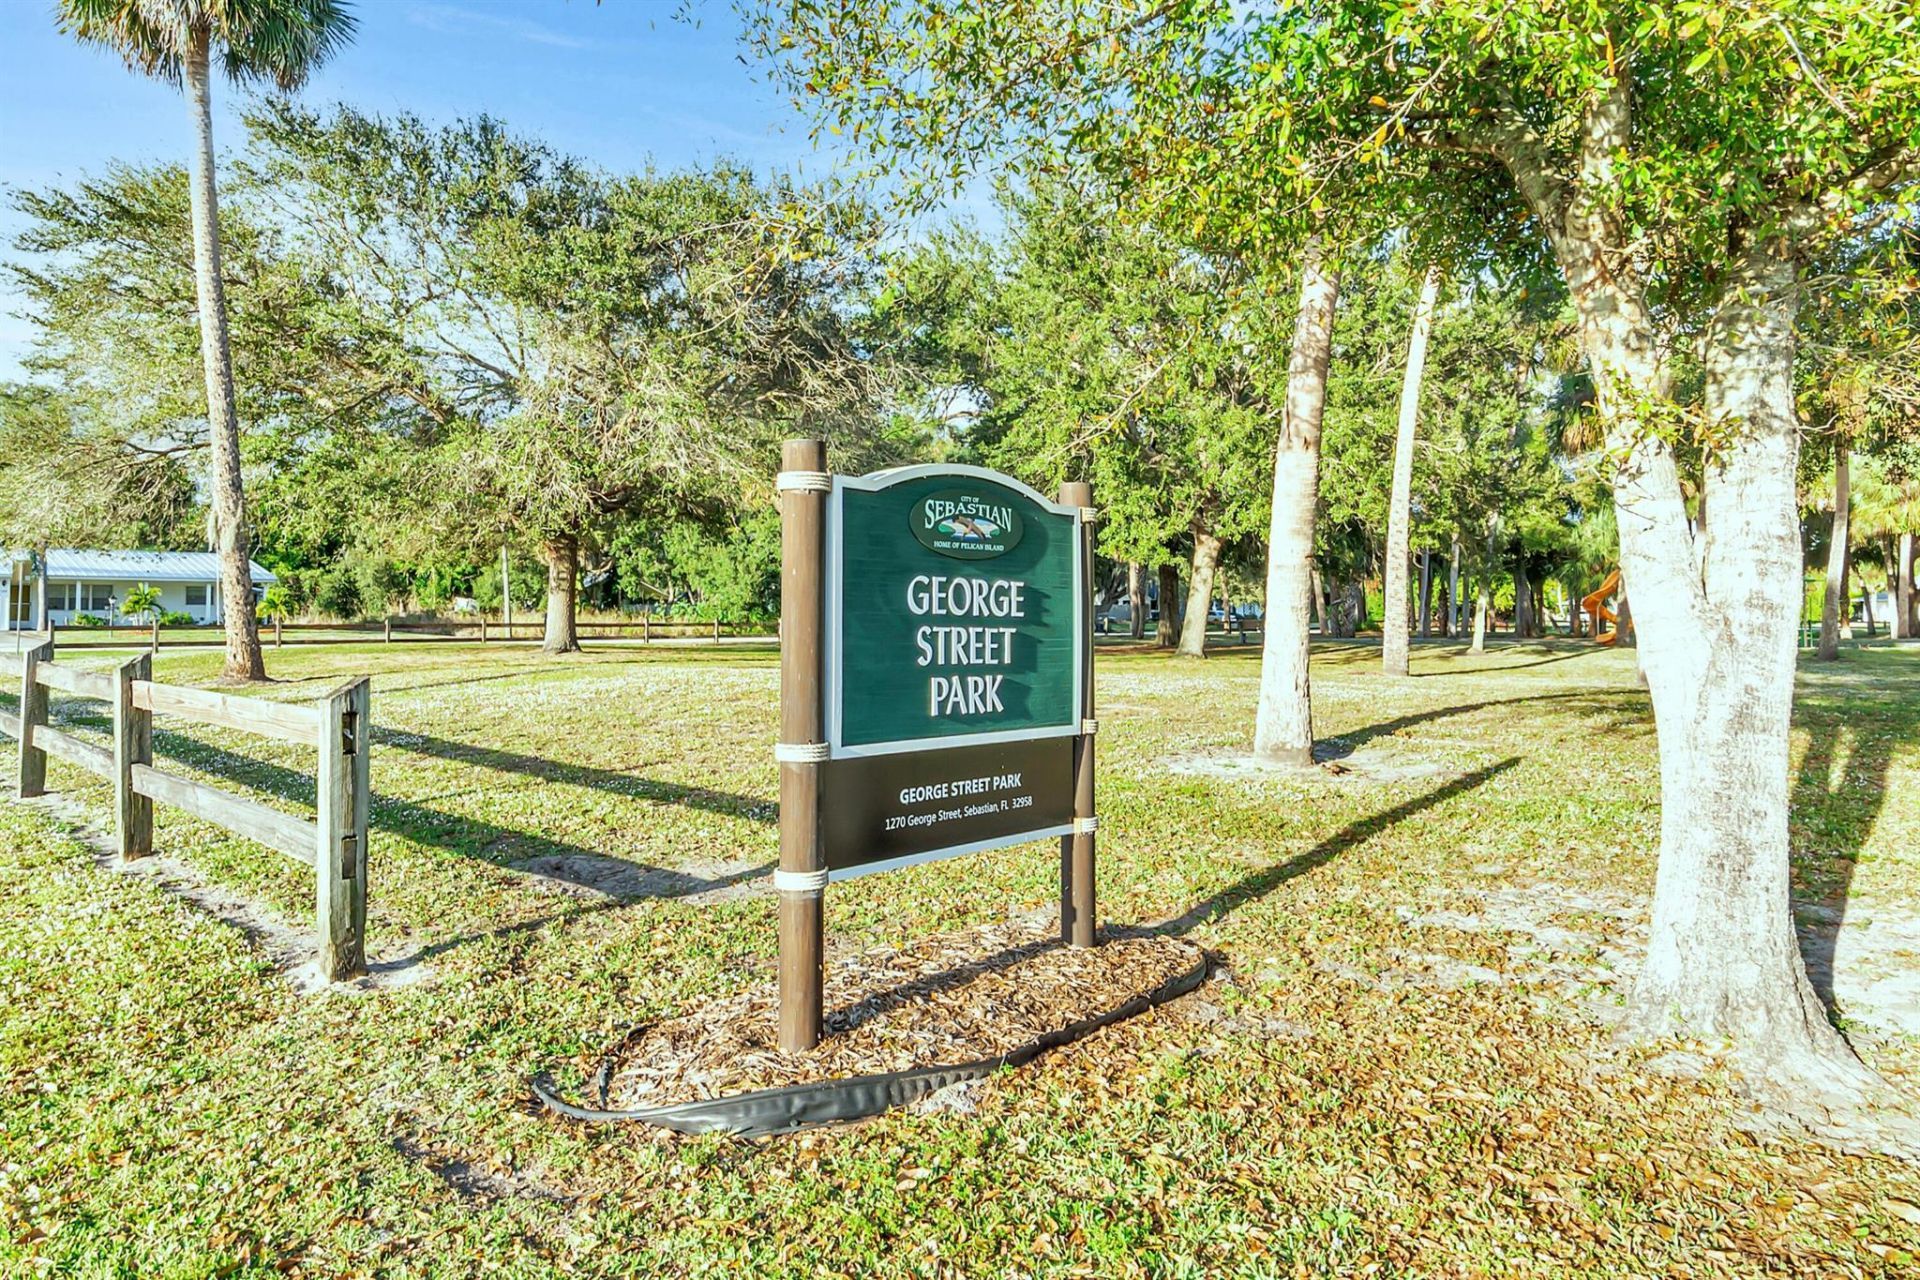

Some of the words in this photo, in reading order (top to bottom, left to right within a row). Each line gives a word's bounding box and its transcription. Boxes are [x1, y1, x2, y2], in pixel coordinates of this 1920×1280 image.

[924, 499, 1012, 533] SEBASTIAN
[933, 540, 951, 549] HOME
[951, 541, 960, 549] OF
[960, 542, 984, 550] PELICAN
[984, 544, 1005, 552] ISLAND
[906, 575, 1025, 617] GEORGE
[916, 625, 1017, 667] STREET
[930, 674, 1004, 717] PARK
[899, 783, 949, 805] GEORGE
[950, 777, 991, 797] STREET
[993, 773, 1022, 791] PARK
[885, 816, 906, 831] 1270
[907, 812, 937, 827] George
[938, 807, 962, 821] Street,
[963, 802, 999, 818] Sebastian,
[1000, 799, 1009, 810] FL
[1012, 795, 1033, 809] 32958
